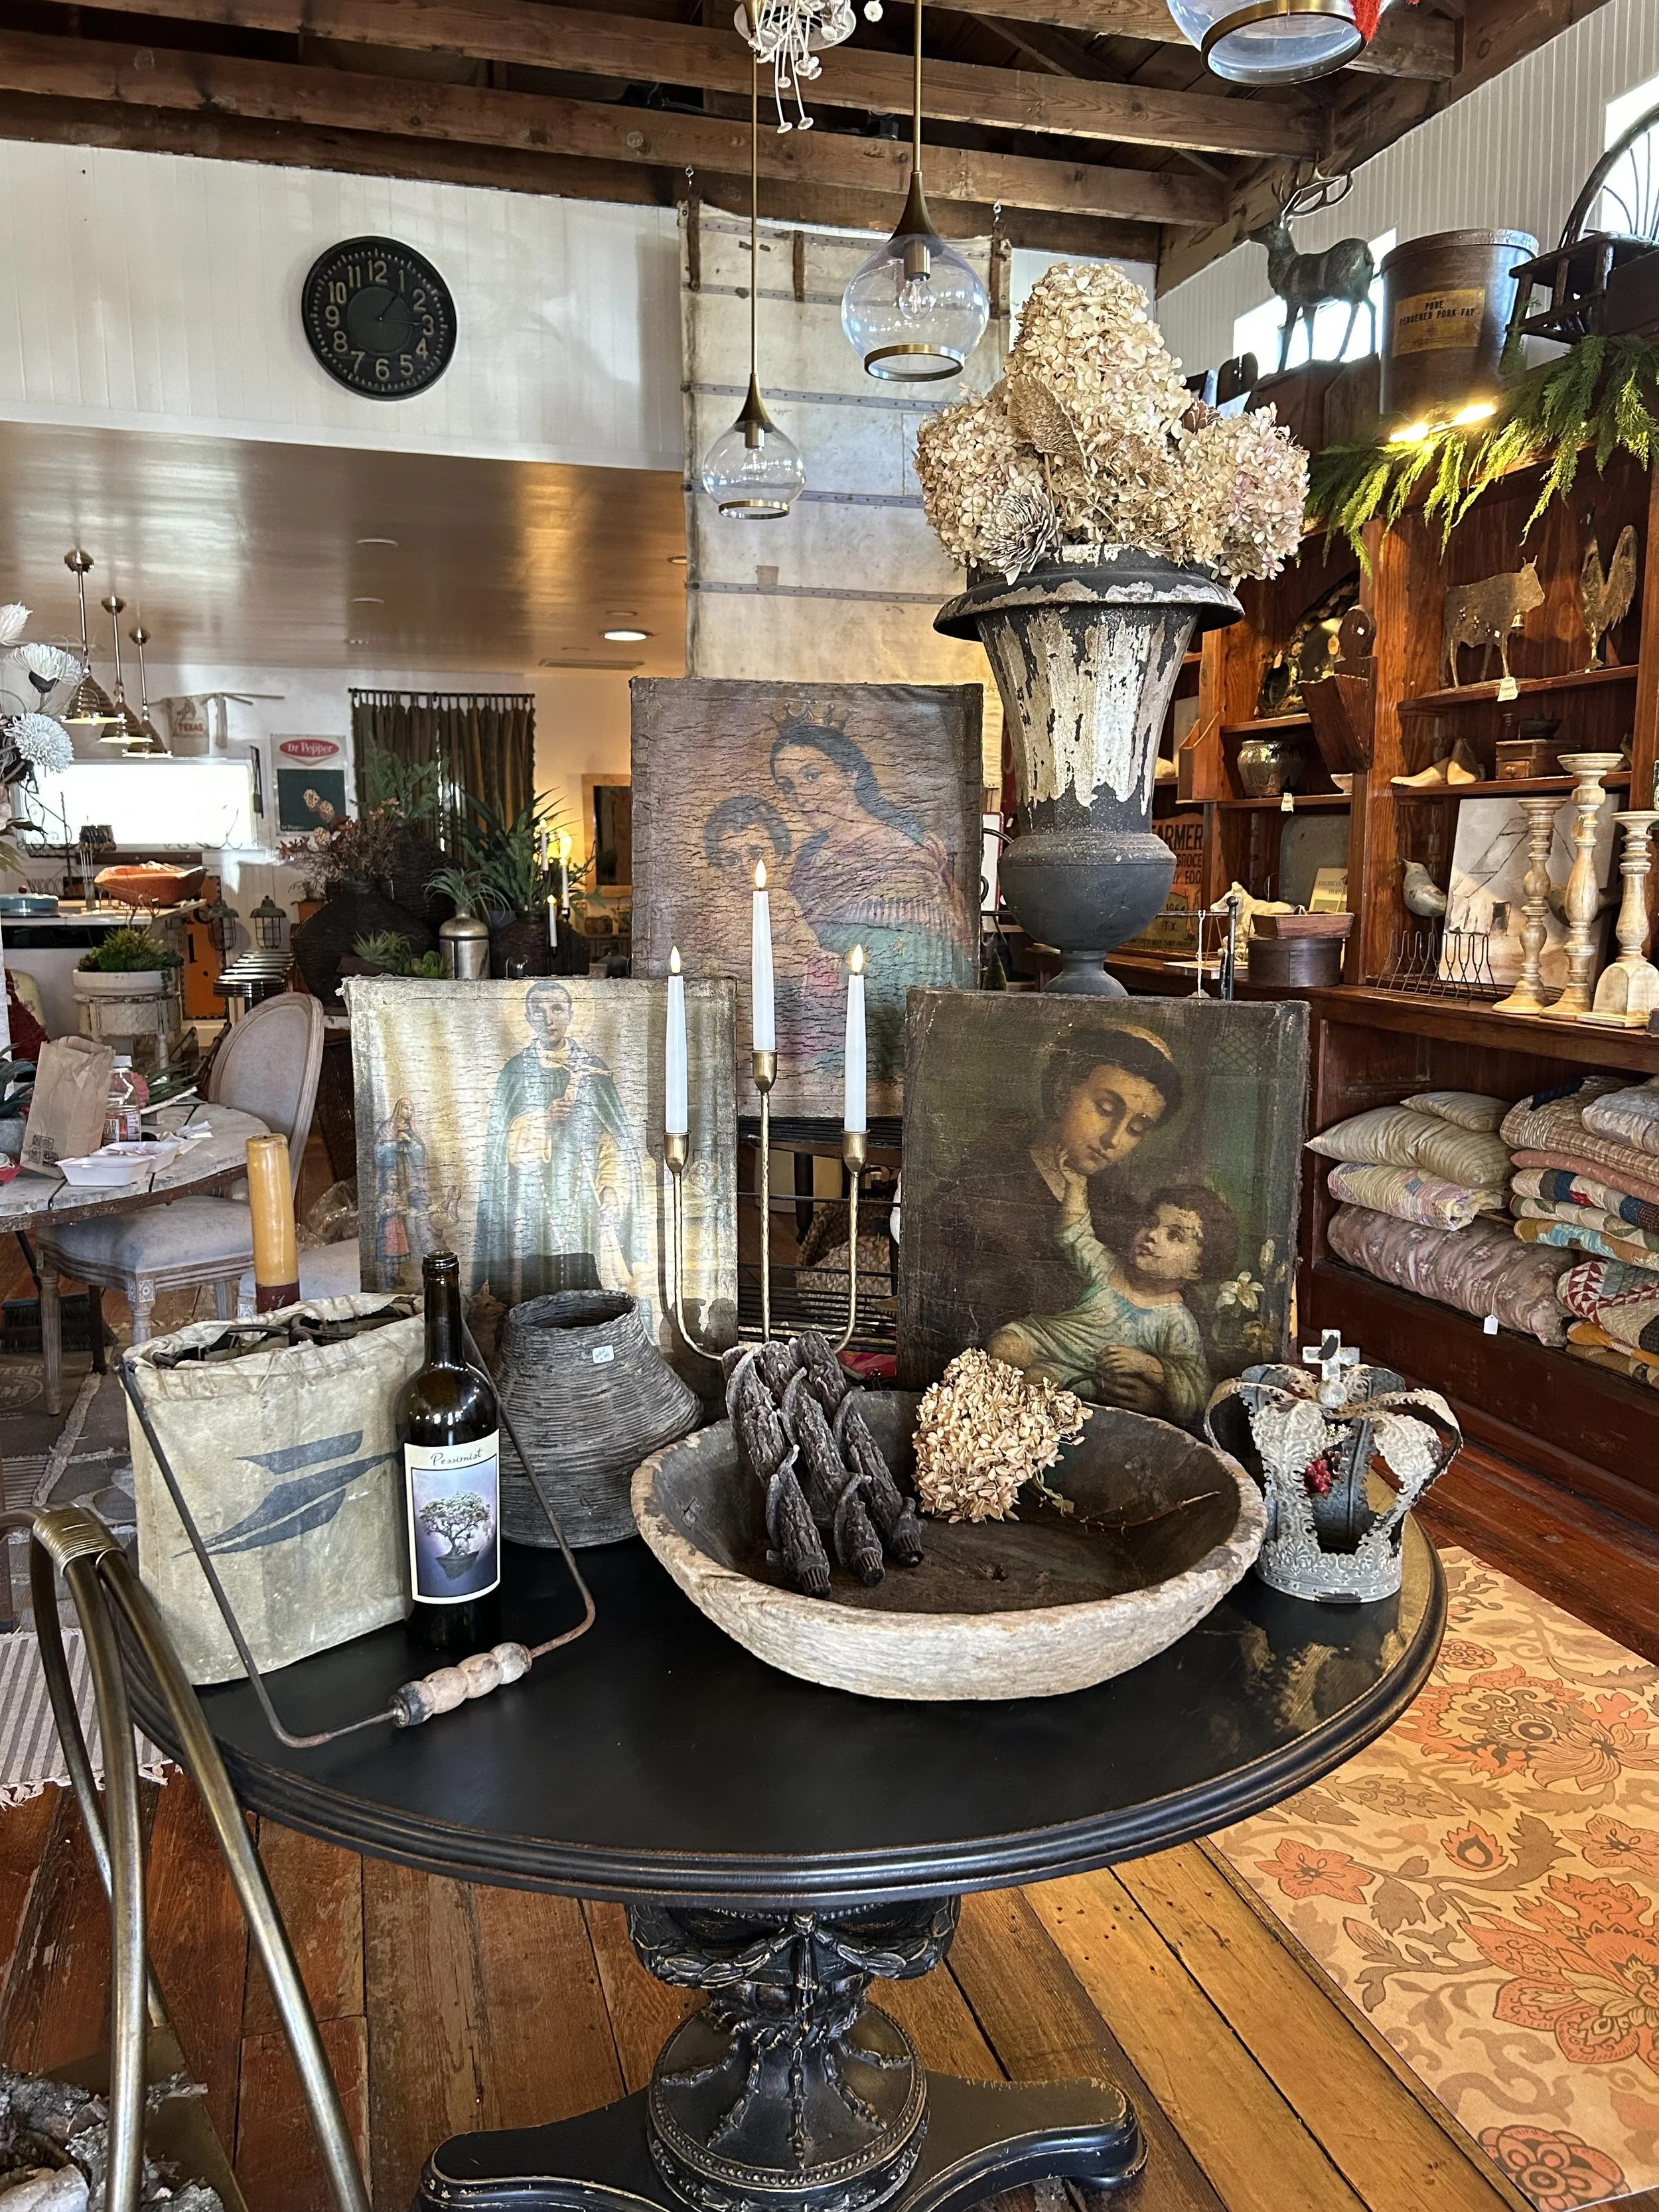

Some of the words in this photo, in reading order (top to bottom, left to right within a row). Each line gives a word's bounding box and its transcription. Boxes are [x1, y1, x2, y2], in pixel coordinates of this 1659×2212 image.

[347, 265, 362, 288] 11
[367, 259, 388, 283] 12
[398, 269, 405, 293] 1
[328, 281, 346, 304] 10
[412, 288, 427, 312] 2
[325, 305, 339, 328] 9
[1424, 300, 1445, 311] PURE
[421, 314, 434, 336] 3
[1399, 311, 1433, 327] RENDERED
[1436, 309, 1457, 319] PORK
[1461, 308, 1475, 317] FAT
[333, 330, 348, 353] 8
[415, 337, 429, 360] 4
[350, 350, 366, 374] 7
[375, 357, 390, 381] 6
[399, 354, 414, 376] 5
[178, 723, 203, 732] TEXAS
[287, 743, 300, 753] Dr
[301, 742, 334, 756] Pepper
[431, 1447, 484, 1467] Pessimist
